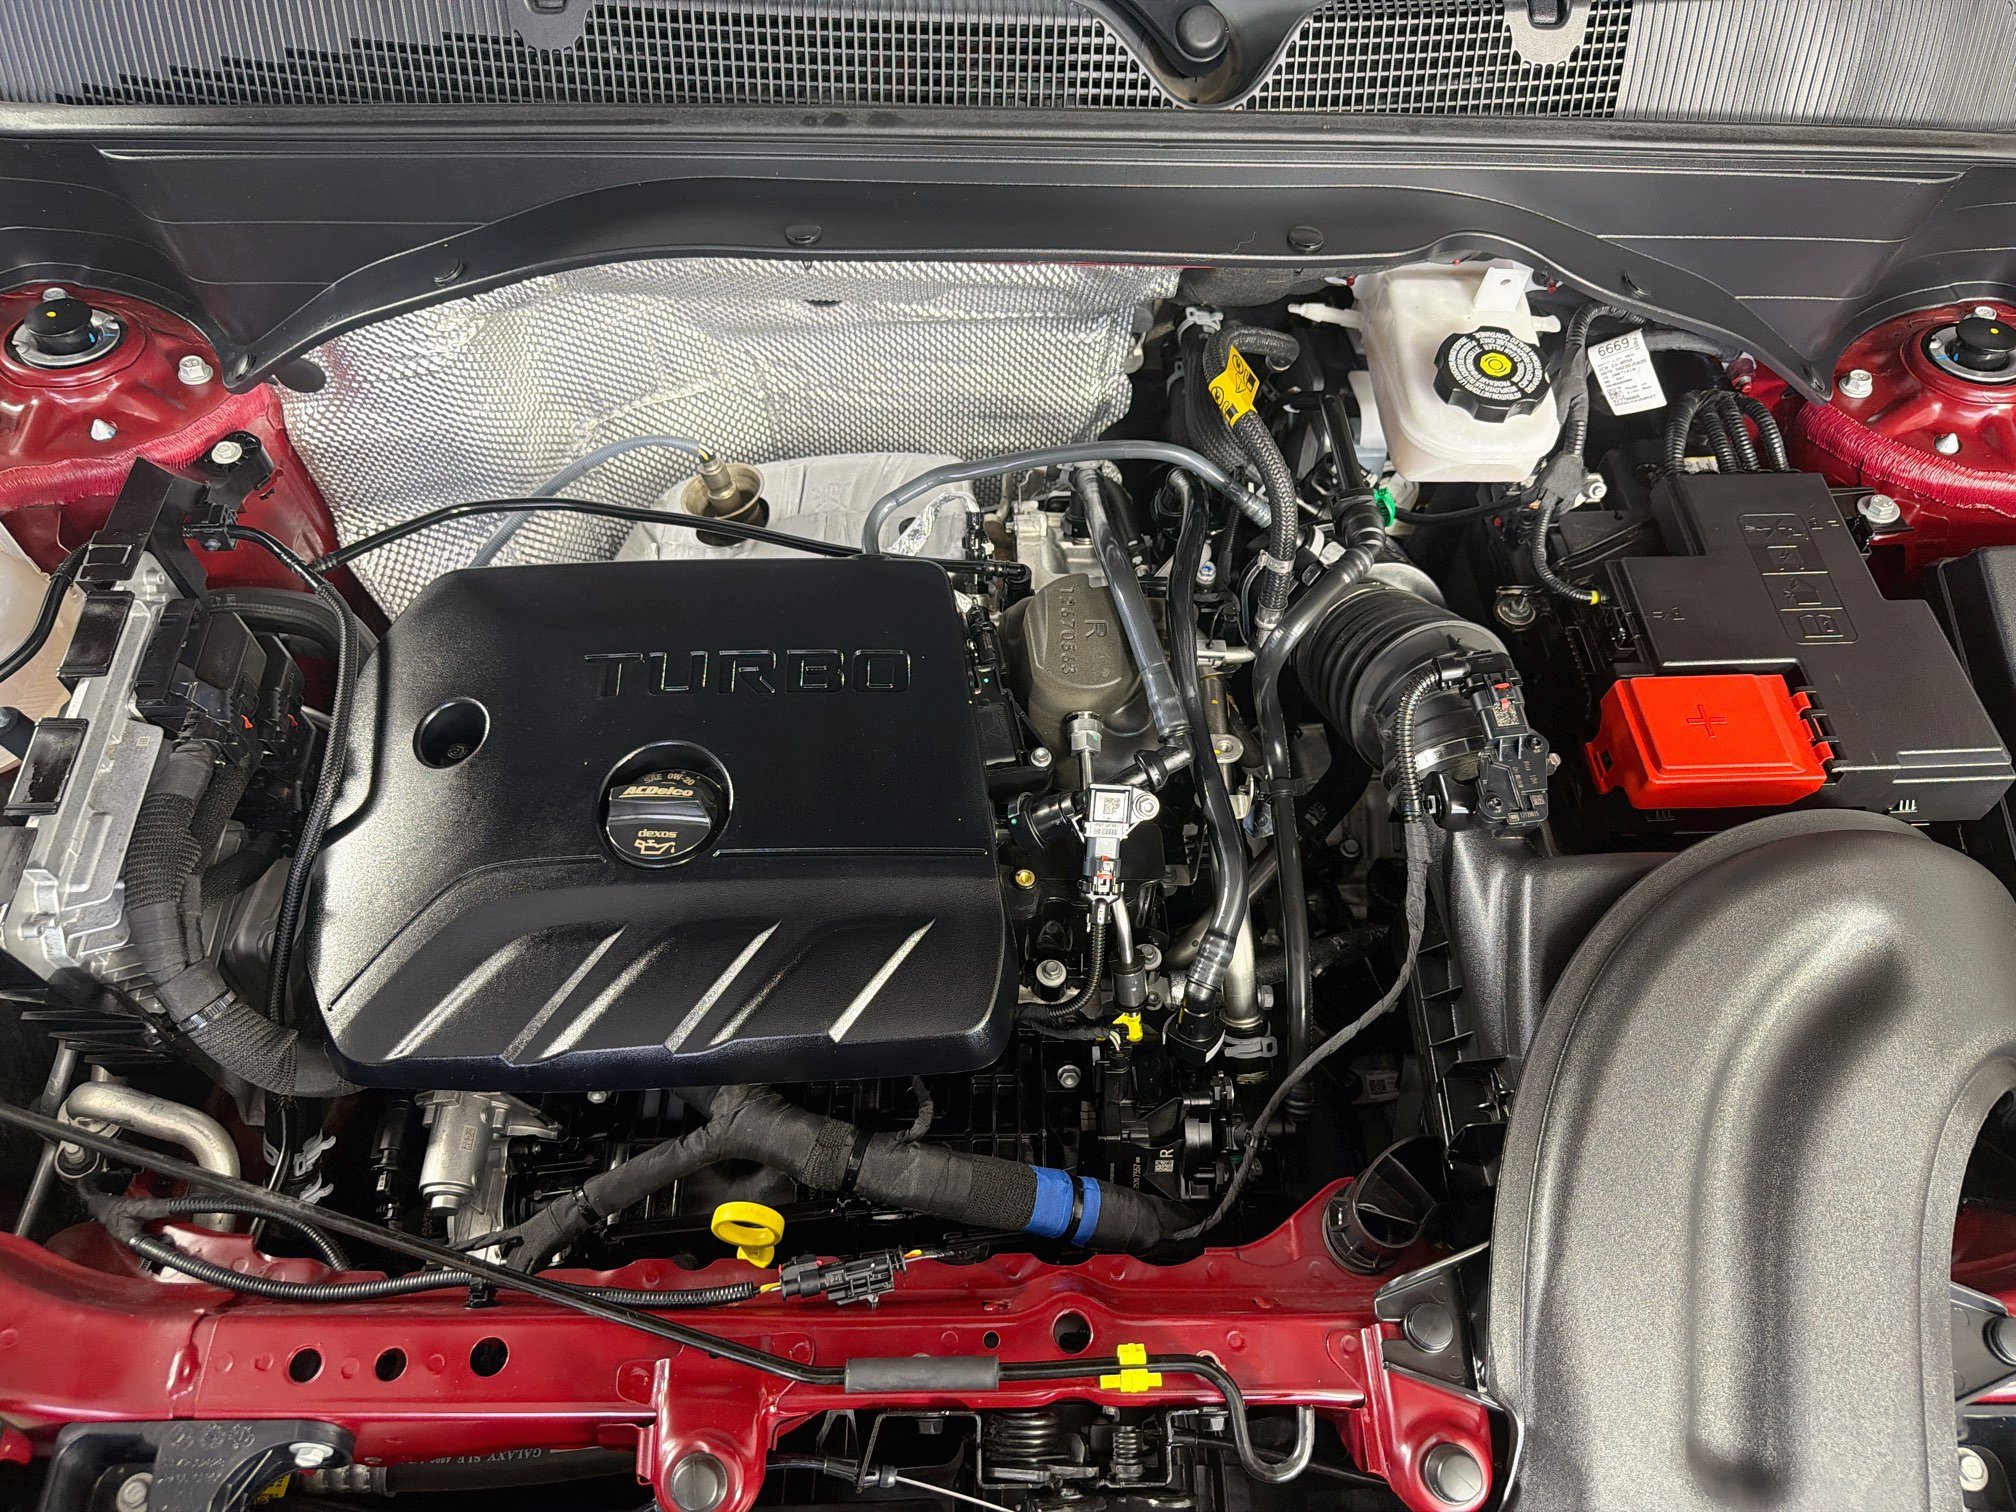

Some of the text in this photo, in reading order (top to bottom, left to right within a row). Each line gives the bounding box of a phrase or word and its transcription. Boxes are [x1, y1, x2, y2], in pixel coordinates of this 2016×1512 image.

[1598, 338, 1629, 356] 6669
[1084, 619, 1108, 639] R
[583, 649, 912, 697] TURBO
[644, 773, 696, 786] SAE 0W-20
[621, 785, 695, 797] ACDelco
[638, 828, 678, 838] dexos
[1160, 1148, 1174, 1158] R
[487, 1447, 542, 1463] GALAXY
